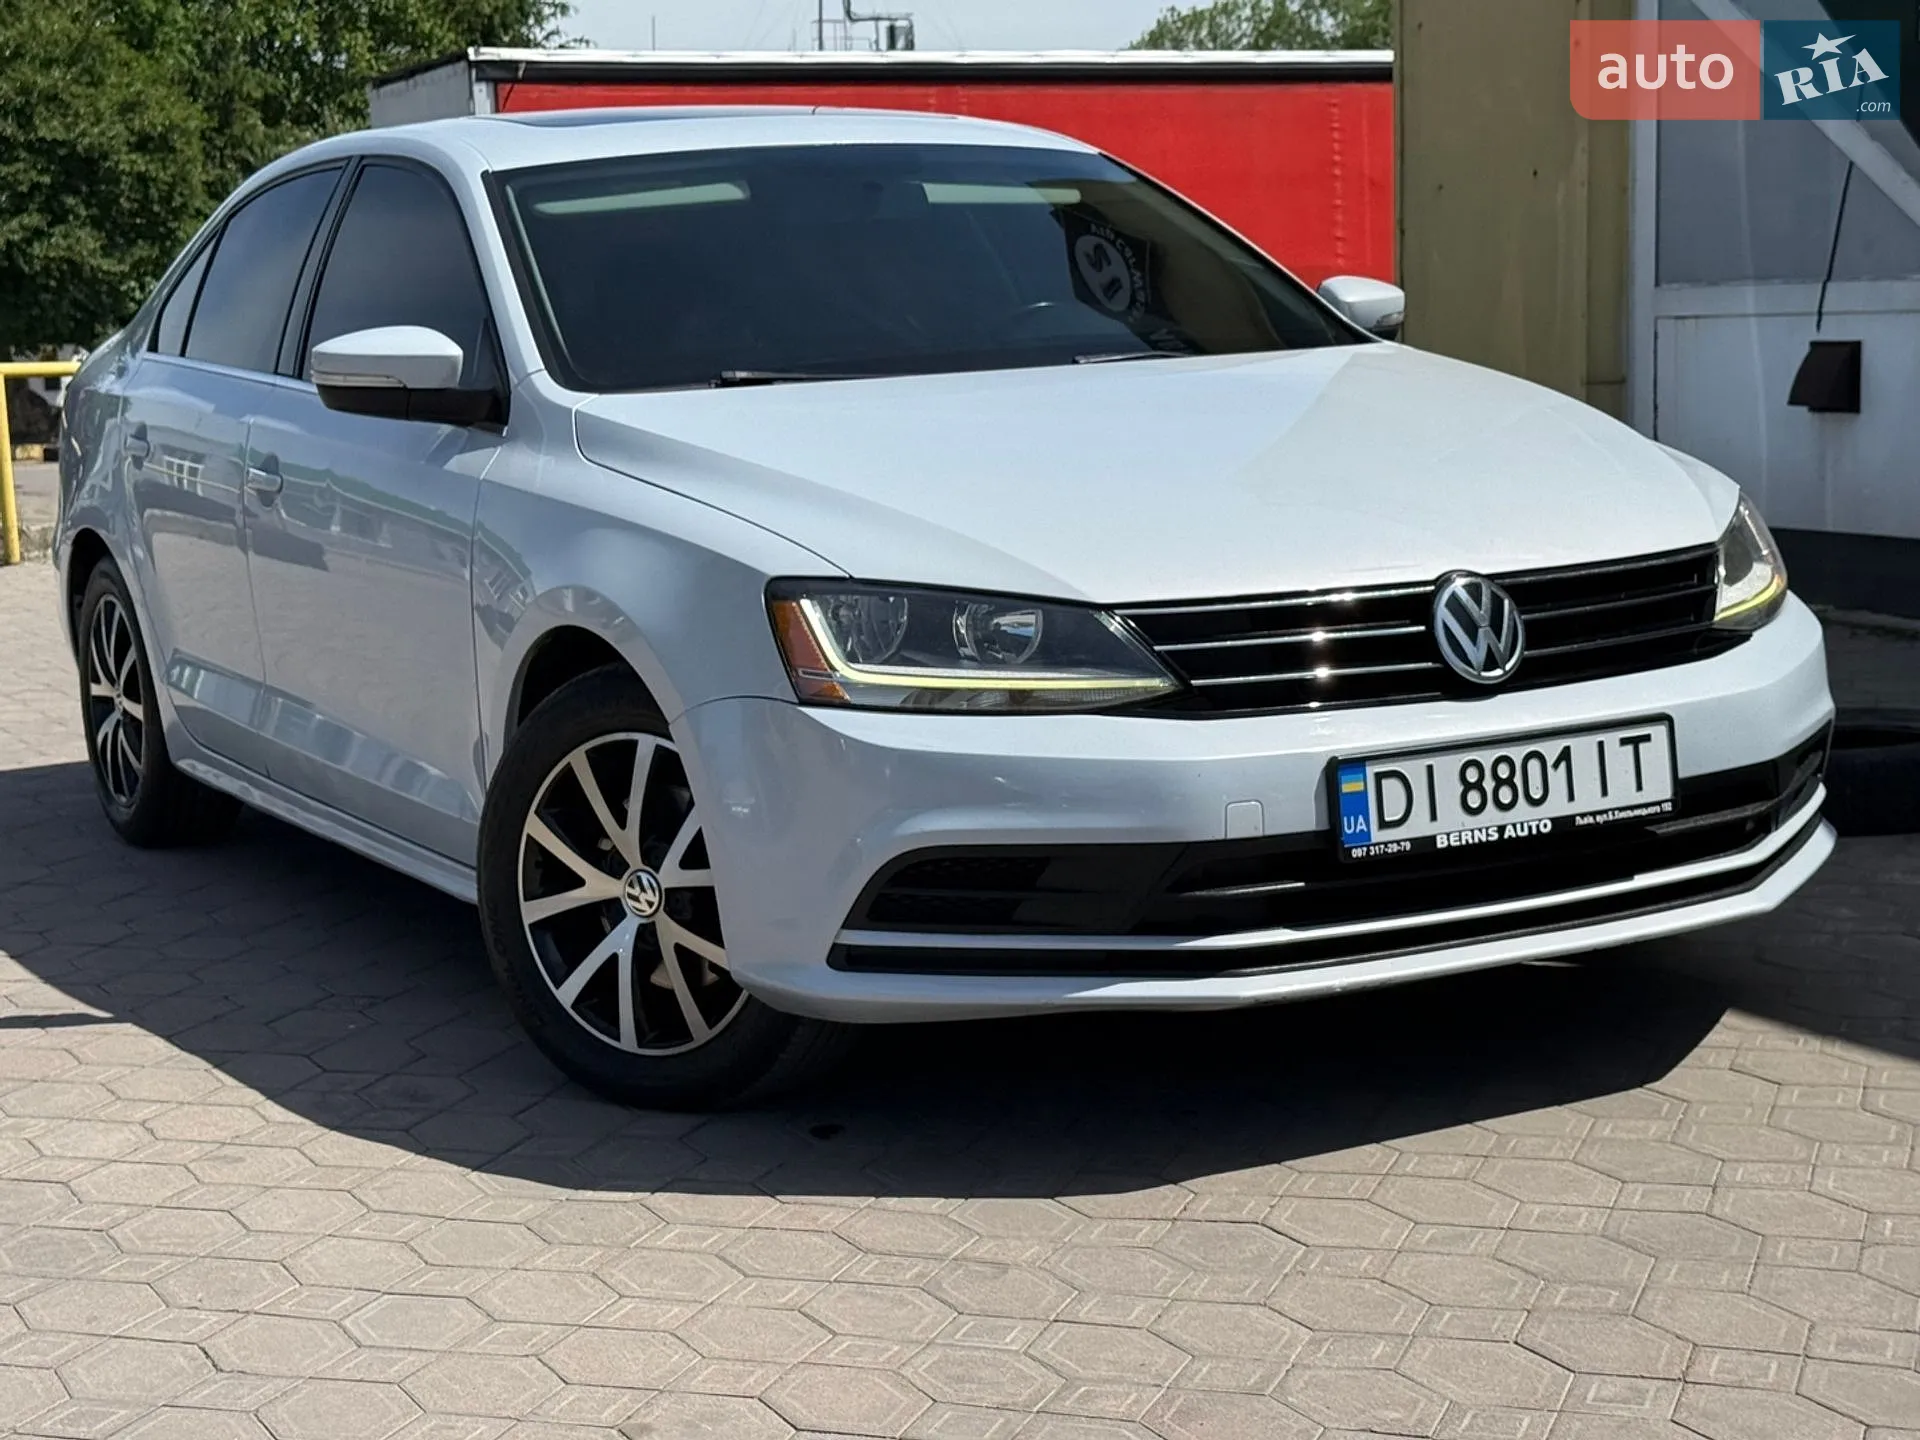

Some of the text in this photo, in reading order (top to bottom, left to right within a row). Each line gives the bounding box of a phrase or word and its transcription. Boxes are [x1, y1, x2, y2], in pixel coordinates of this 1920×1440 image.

[1374, 733, 1652, 831] DI 8801 IT
[1343, 814, 1368, 834] UA
[1436, 817, 1553, 849] BERNS AUTO
